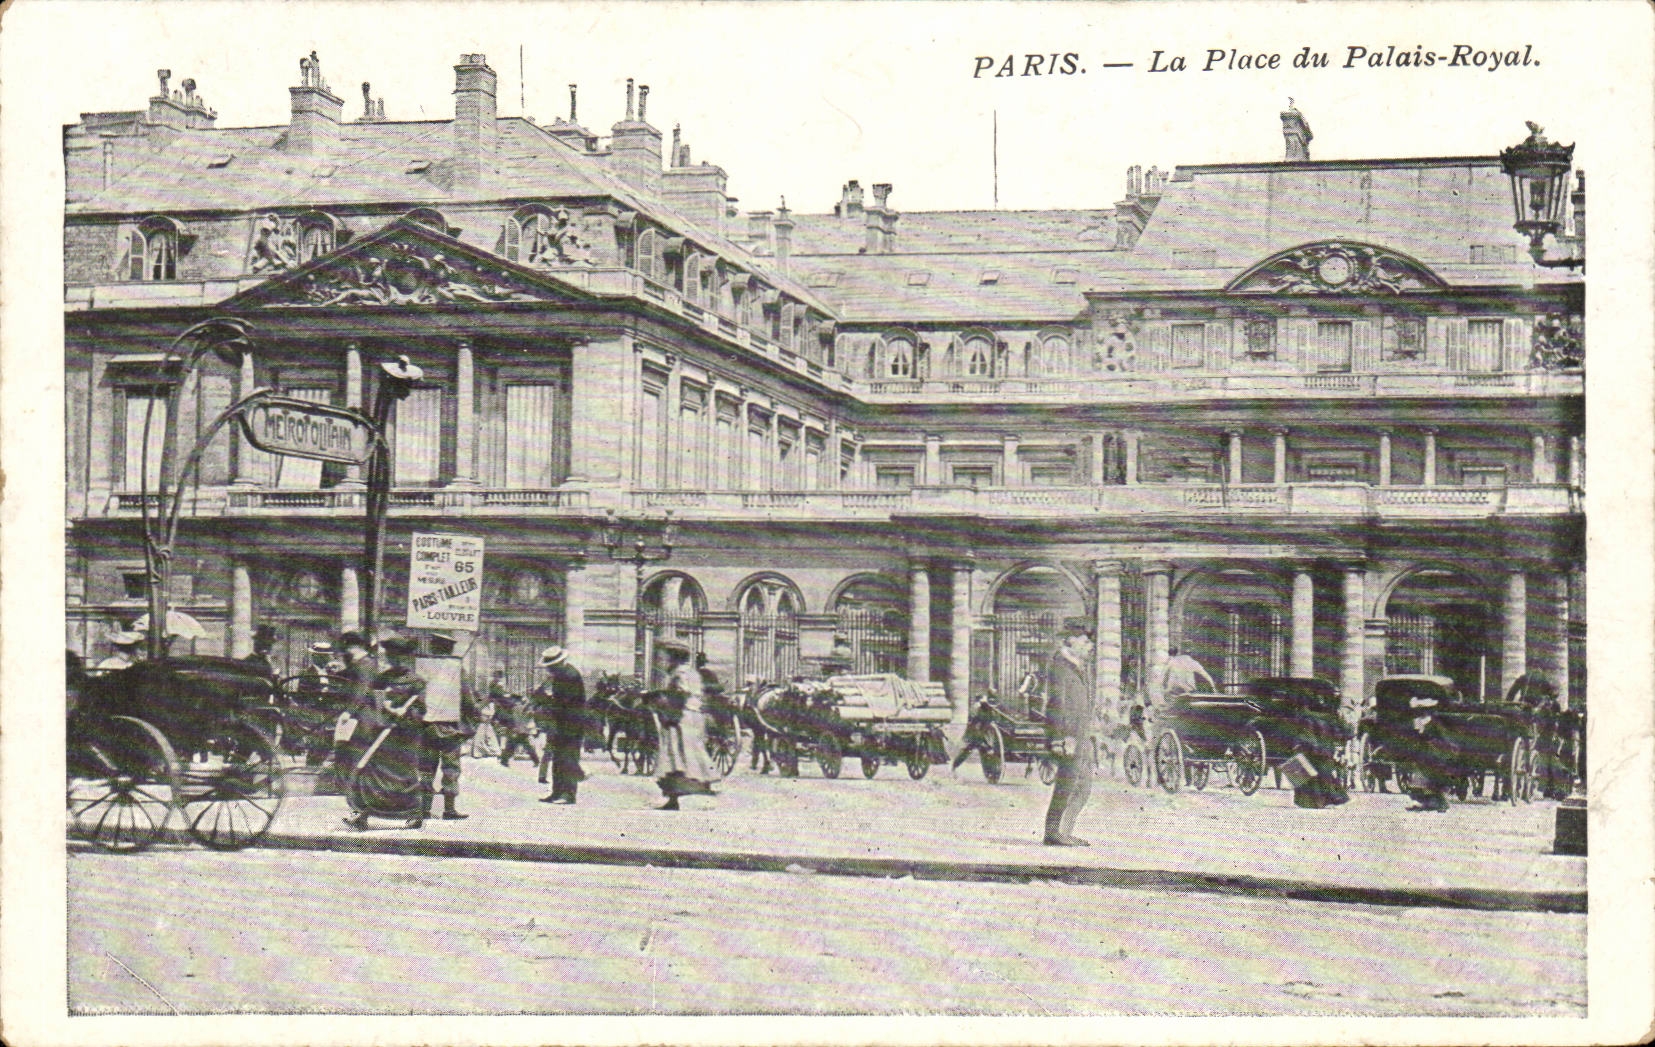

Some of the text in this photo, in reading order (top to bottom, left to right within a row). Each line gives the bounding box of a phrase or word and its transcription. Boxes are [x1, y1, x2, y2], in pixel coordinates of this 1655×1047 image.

[416, 551, 450, 563] COMPLET
[455, 561, 474, 573] 65
[427, 612, 474, 622] LOUVRE
